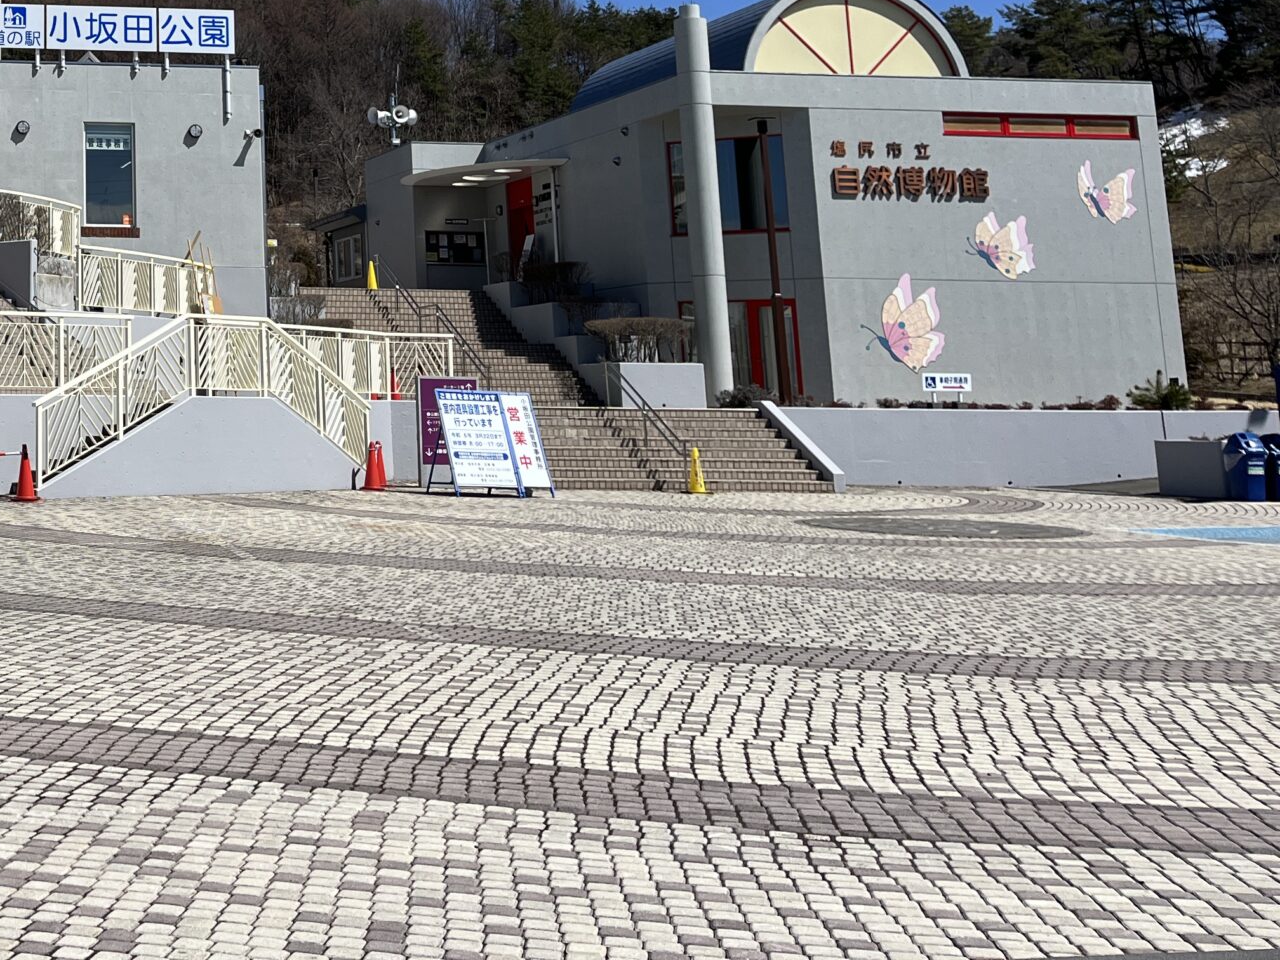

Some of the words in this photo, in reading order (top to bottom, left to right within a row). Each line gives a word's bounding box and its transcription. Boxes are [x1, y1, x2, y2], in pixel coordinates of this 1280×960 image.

[49, 11, 230, 47] 小坂田公園
[830, 140, 930, 160] 塩尻市立
[830, 165, 989, 201] 自然博物館
[442, 403, 499, 416] 室内遊具設置工事を
[454, 417, 492, 427] 行っています
[506, 406, 533, 470] 営業中
[520, 398, 543, 470] 小坂田公園管理事務所
